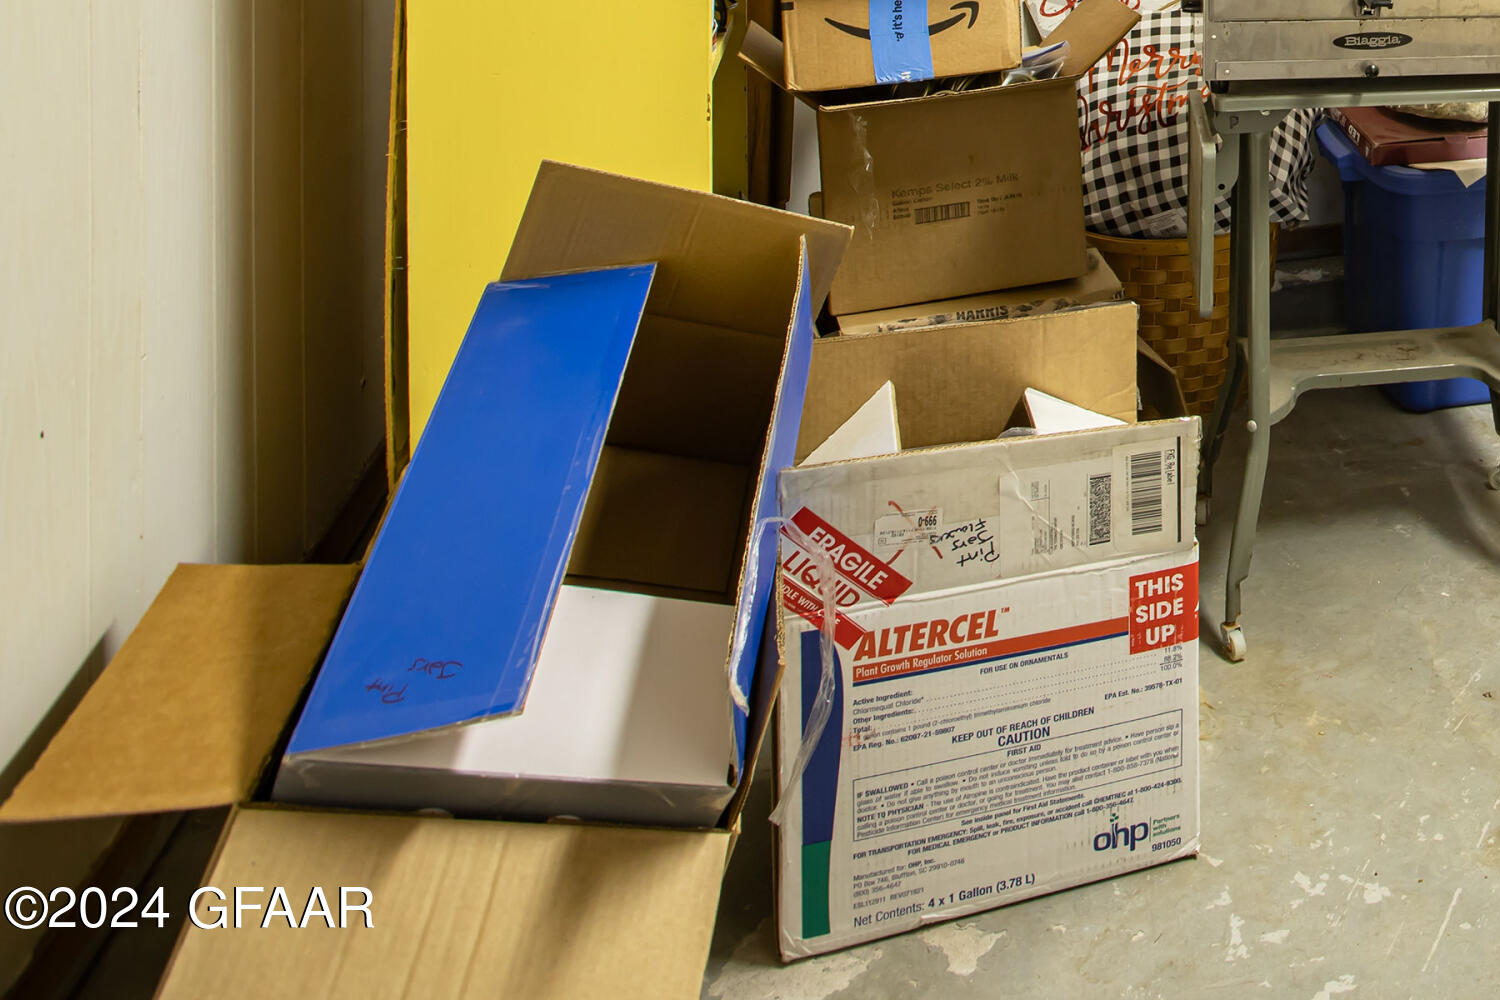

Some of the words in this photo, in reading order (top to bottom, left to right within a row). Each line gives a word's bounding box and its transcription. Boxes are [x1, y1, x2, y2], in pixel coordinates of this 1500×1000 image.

[892, 14, 903, 30] it's
[1344, 35, 1401, 47] Biaggia
[892, 185, 932, 198] Kemps
[936, 180, 971, 192] Select
[996, 172, 1019, 184] Milk
[804, 524, 889, 592] FRAGILE
[956, 541, 1000, 567] Pint
[1135, 573, 1183, 598] THIS
[796, 595, 818, 614] WITH
[1135, 597, 1183, 623] SIDE
[1146, 623, 1175, 646] UP
[855, 664, 877, 679] Plant
[879, 659, 909, 674] Growth
[912, 651, 952, 670] Regulator
[954, 645, 987, 660] Solution
[979, 666, 993, 675] FOR
[994, 664, 1006, 672] USE
[1019, 651, 1068, 667] ORNAMENTALS
[853, 696, 873, 707] Active
[875, 689, 912, 703] Ingredient:
[1104, 691, 1116, 700] EPA
[1118, 689, 1128, 697] Est.
[1131, 686, 1143, 694] No.:
[853, 715, 871, 725] Other
[873, 707, 913, 721] Ingredients:
[951, 732, 973, 743] KEEP
[976, 728, 992, 738] OUT
[996, 725, 1007, 734] OF
[1009, 718, 1037, 731] REACH
[1040, 715, 1050, 724] OF
[1053, 706, 1094, 722] CHILDREN
[853, 724, 872, 733] Total:
[998, 725, 1049, 747] CAUTION
[853, 744, 865, 752] EPA
[868, 740, 882, 750] Reg.
[885, 737, 898, 745] No.:
[1007, 747, 1025, 757] FIRST
[1029, 743, 1040, 752] AID
[865, 782, 908, 797] SWALLOWED
[857, 814, 874, 823] NOTE
[877, 811, 885, 819] TO
[887, 803, 923, 816] PHYSICIAN
[1153, 813, 1179, 825] Partners
[908, 847, 920, 855] FOR
[922, 840, 950, 852] MEDICAL
[953, 830, 991, 845] EMERGENCY
[1001, 821, 1029, 833] PRODUCT
[1031, 811, 1072, 826] INFORMATION
[1074, 808, 1084, 816] call
[1153, 823, 1166, 831] with
[853, 851, 867, 859] FOR
[869, 837, 926, 856] TRANSPORTATION
[1151, 837, 1181, 852] 981050
[854, 913, 872, 927] Net
[875, 901, 924, 922] Contents:
[928, 898, 934, 908] 4
[939, 897, 944, 905] x
[949, 893, 953, 903] 1
[958, 883, 992, 901] Gallon
[996, 876, 1022, 893] (3.78
[1025, 873, 1034, 886] L)
